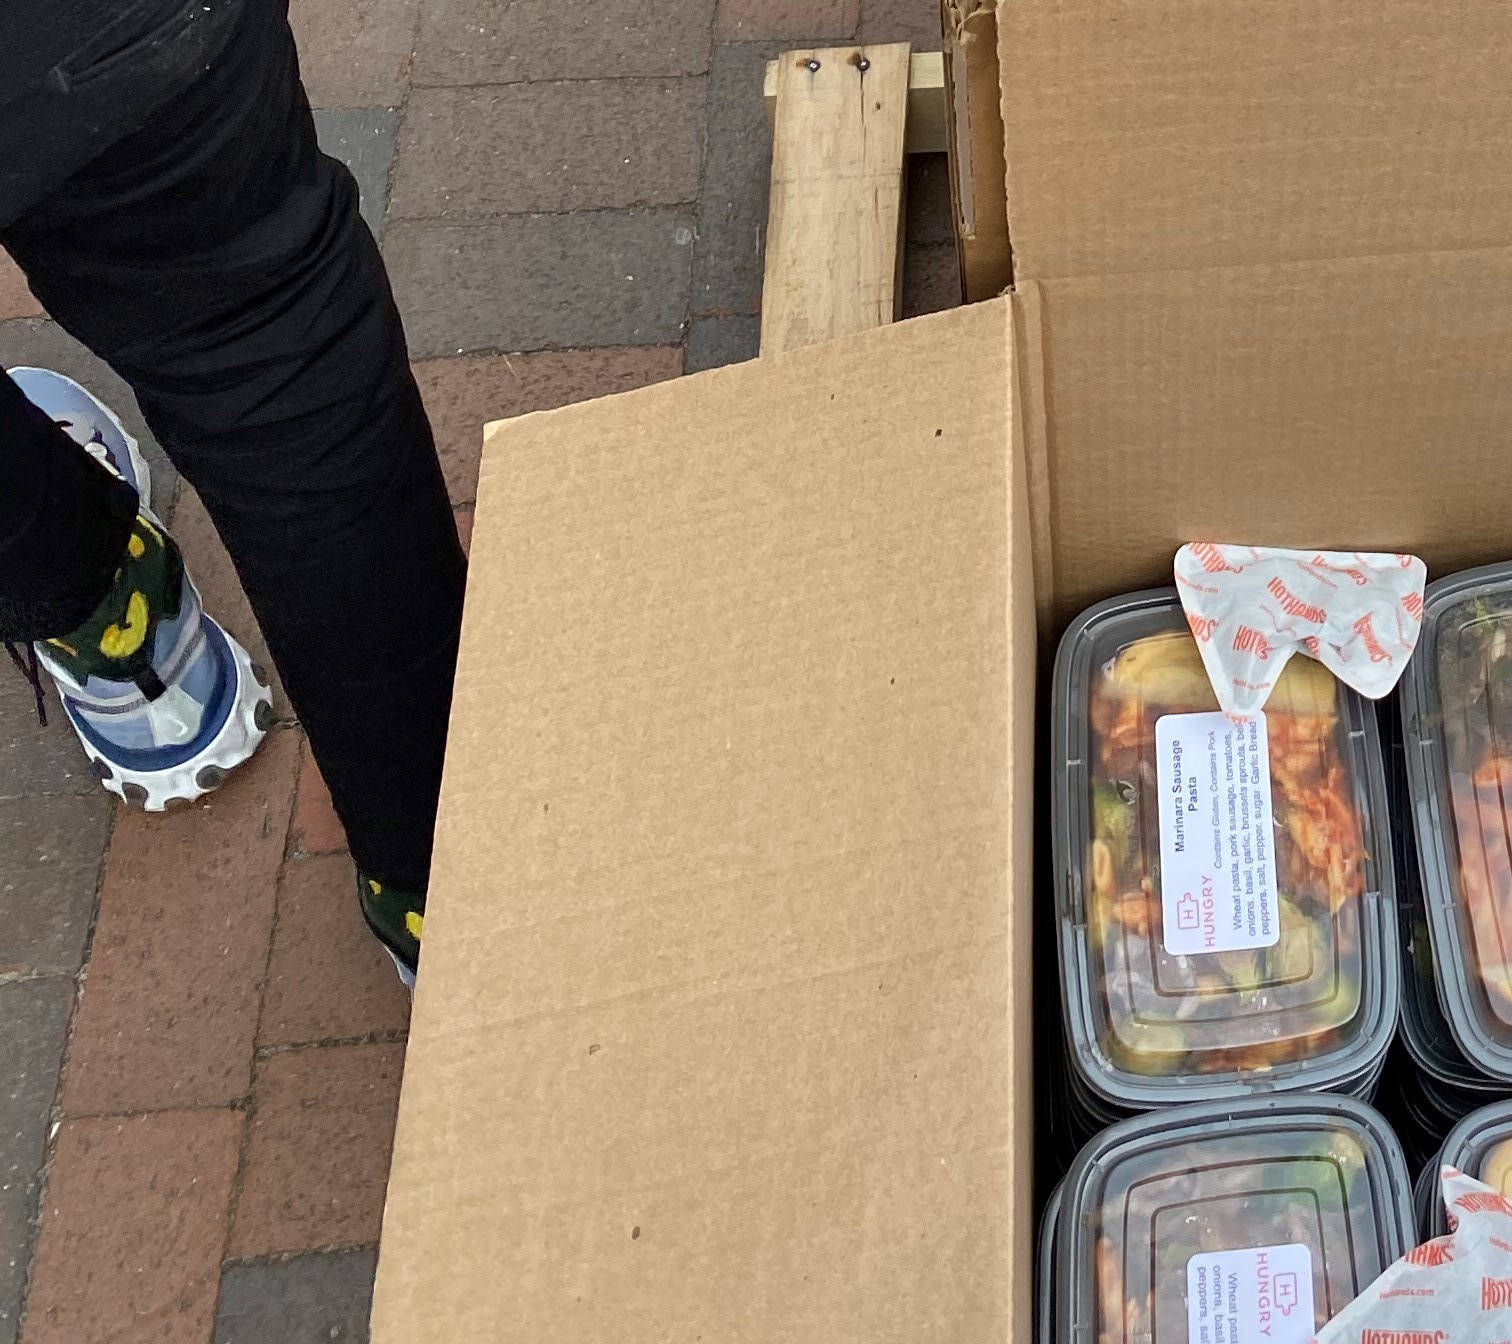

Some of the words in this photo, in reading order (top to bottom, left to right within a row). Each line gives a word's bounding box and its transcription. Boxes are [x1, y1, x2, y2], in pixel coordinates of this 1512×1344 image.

[1247, 720, 1258, 751] Bread
[1171, 739, 1183, 793] Sausage
[1223, 730, 1234, 781] tomatoes,
[1236, 742, 1249, 784] sprouts,
[1249, 753, 1260, 785] Garlic
[1188, 776, 1199, 812] Pasta
[1227, 783, 1238, 831] sausage,
[1238, 786, 1250, 830] brussels
[1173, 796, 1185, 852] Marinara
[1255, 822, 1267, 861] pepper,
[1228, 833, 1241, 857] pork
[1241, 832, 1254, 864] garlic,
[1230, 859, 1243, 892] pasta,
[1242, 866, 1254, 895] basil,
[1256, 863, 1267, 886] salt,
[1183, 909, 1194, 920] H
[1201, 875, 1216, 948] HUNGRY
[1231, 894, 1243, 931] Wheat
[1246, 898, 1257, 937] onions,
[1259, 888, 1272, 935] peppers,
[1196, 1266, 1208, 1322] peppers,
[1212, 1264, 1222, 1311] onions,
[1227, 1272, 1239, 1314] Wheat
[1256, 1252, 1272, 1337] HUNGRY
[1279, 1283, 1292, 1297] H
